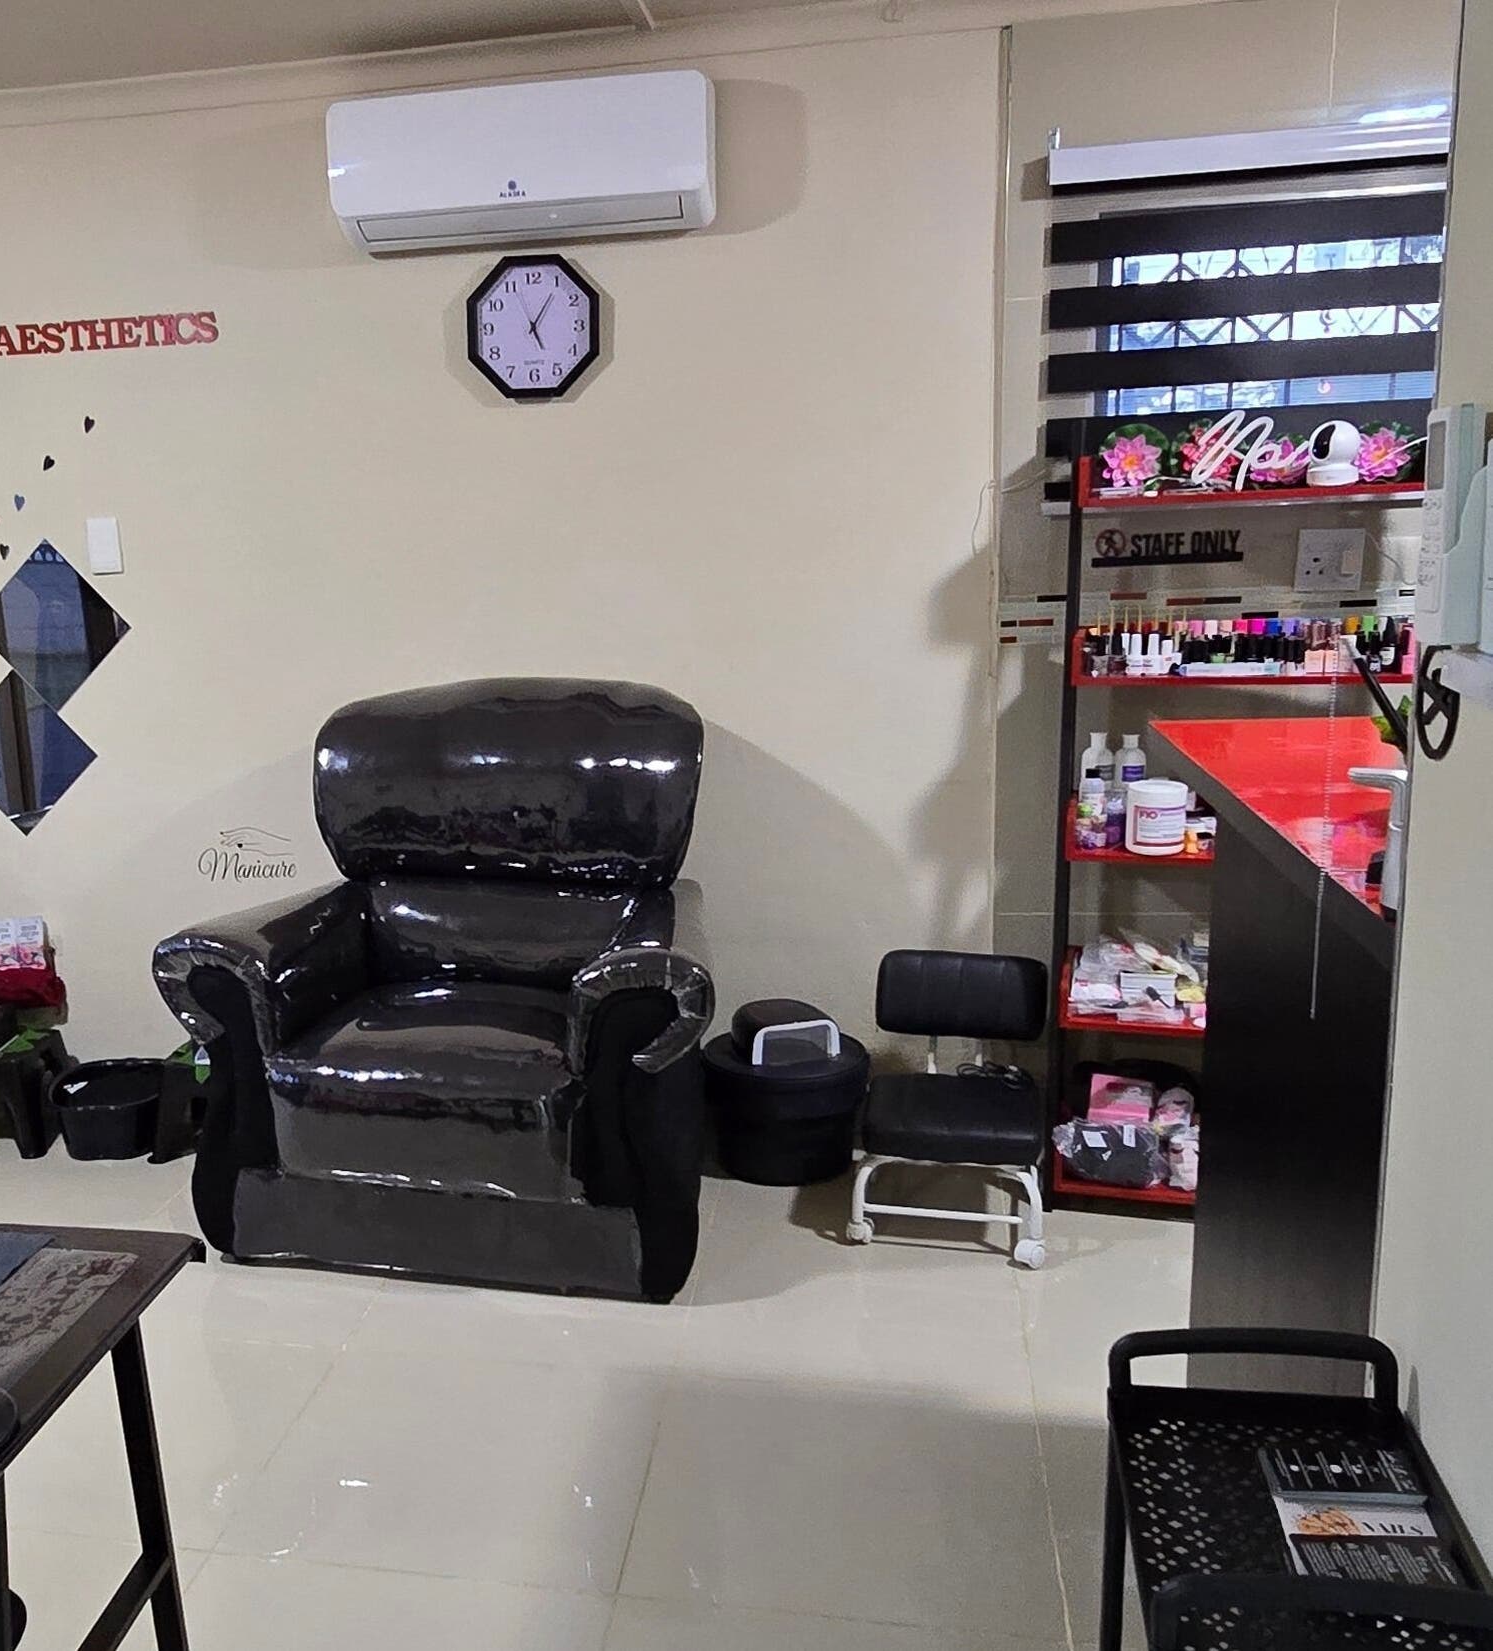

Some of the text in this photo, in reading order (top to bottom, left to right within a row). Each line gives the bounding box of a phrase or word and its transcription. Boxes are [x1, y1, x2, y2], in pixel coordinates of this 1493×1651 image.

[525, 271, 542, 285] 12
[554, 275, 559, 288] 1
[504, 281, 516, 293] 11
[489, 298, 504, 312] 10
[568, 293, 580, 307] 2
[483, 322, 494, 336] 9
[573, 319, 585, 332] 3
[489, 346, 501, 360] 8
[568, 343, 577, 357] 4
[506, 365, 515, 379] 7
[529, 368, 540, 383] 6
[552, 363, 563, 376] 5
[1130, 529, 1241, 556] STAFF ONLY
[197, 847, 297, 883] Manicure
